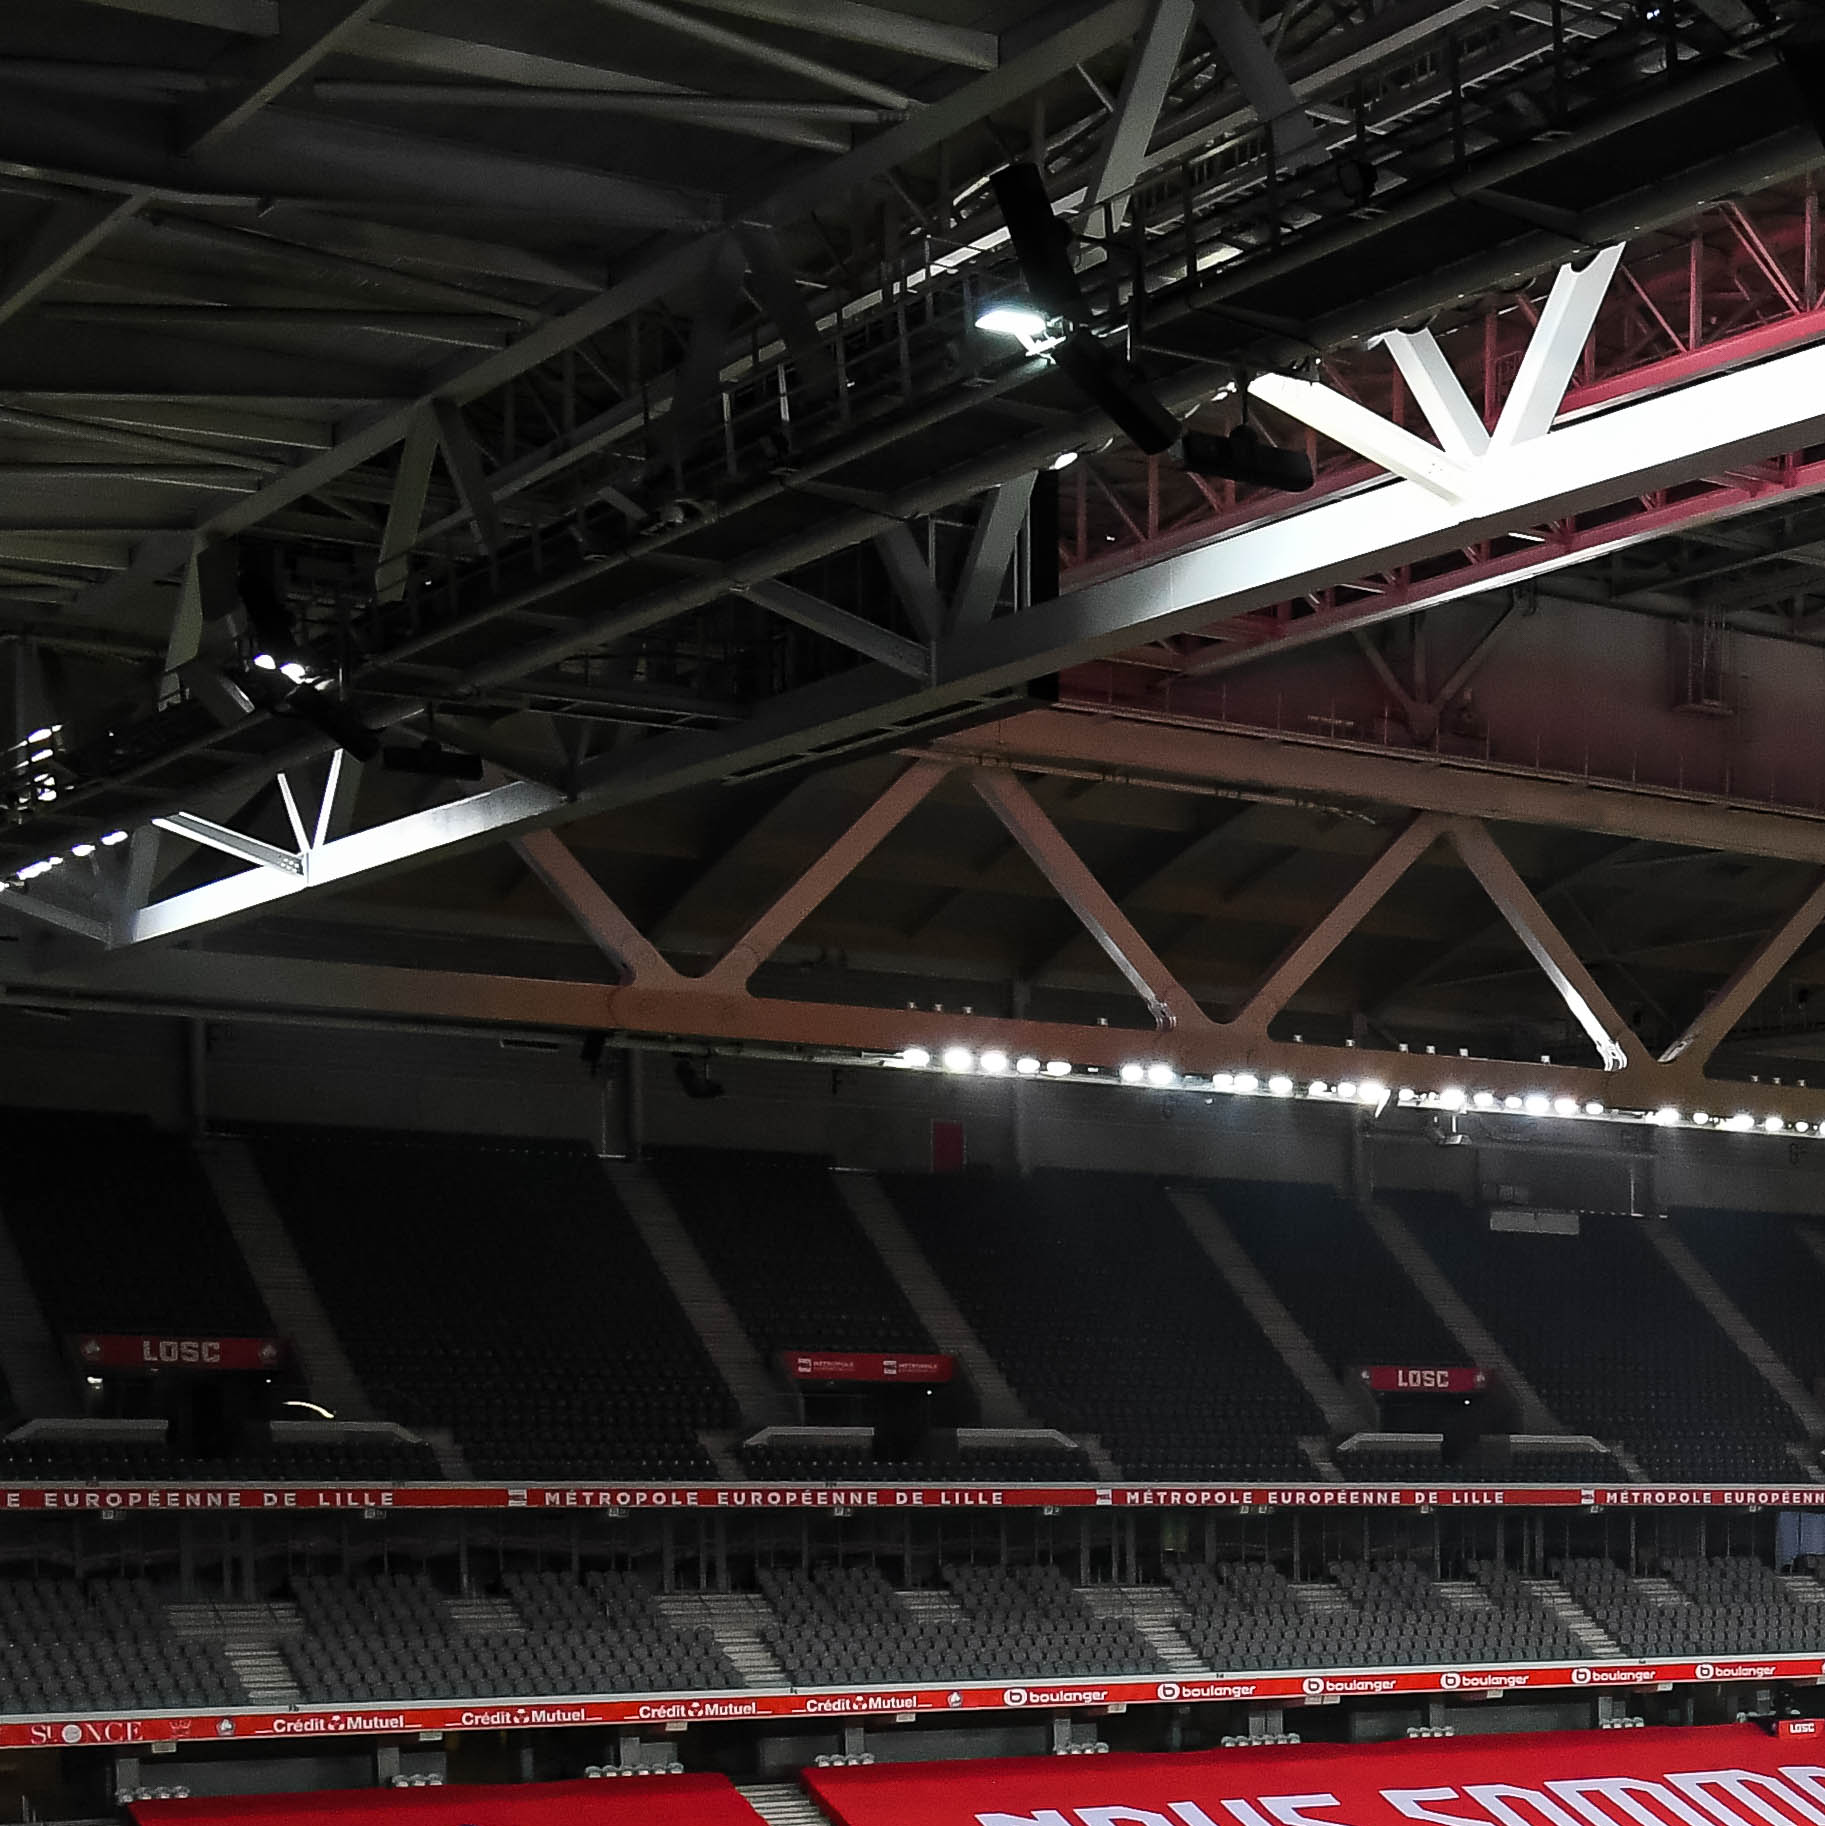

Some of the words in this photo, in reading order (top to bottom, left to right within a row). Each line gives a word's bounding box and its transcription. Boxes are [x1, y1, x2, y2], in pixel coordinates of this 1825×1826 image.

[143, 1340, 221, 1362] LOSC
[1398, 1369, 1449, 1387] LOSC
[45, 1488, 240, 1507] EUROPÉENNE
[264, 1493, 296, 1506] DE
[319, 1492, 392, 1506] LILLE
[546, 1488, 697, 1506] MÉTROPOLE
[718, 1488, 877, 1506] EUROPÉENNE
[896, 1491, 922, 1504] DE
[942, 1491, 1002, 1504] LILLE
[1127, 1488, 1252, 1504] MÉTROPOLE
[1269, 1489, 1400, 1504] EUROPÉENNE
[1415, 1492, 1437, 1503] DE
[1453, 1492, 1503, 1503] LILLE
[1607, 1489, 1711, 1503] MÉTROPOLE
[1462, 1670, 1529, 1688] boulanger
[1593, 1667, 1655, 1682] boulanger
[1716, 1663, 1775, 1678] boulanger
[1182, 1681, 1256, 1699] boulanger
[1326, 1675, 1396, 1693] boulanger
[807, 1697, 851, 1712] Crédit
[868, 1694, 917, 1709] Mutuel
[1029, 1687, 1107, 1705] boulanger
[462, 1711, 509, 1725] Crédit
[531, 1707, 585, 1722] Mutuel
[639, 1703, 685, 1718] Crédit
[705, 1700, 756, 1715] Mutuel
[273, 1717, 324, 1732] Crédit
[347, 1714, 404, 1729] Mutuel
[1790, 1723, 1815, 1733] LOSC
